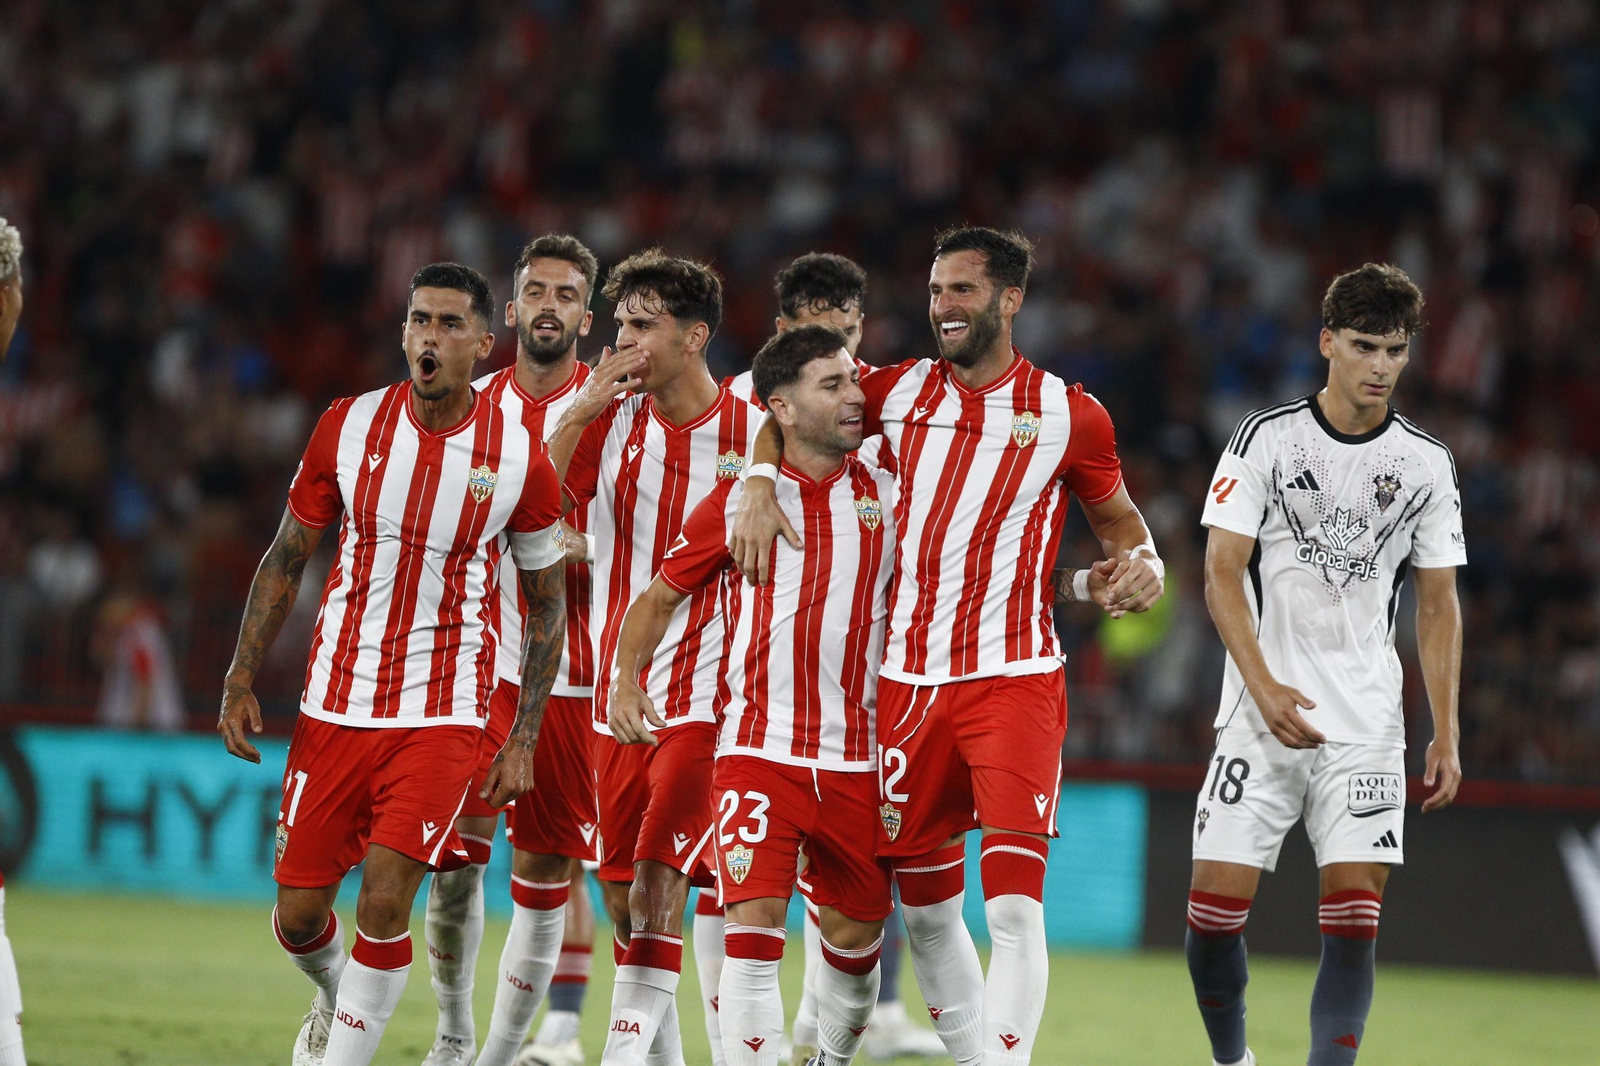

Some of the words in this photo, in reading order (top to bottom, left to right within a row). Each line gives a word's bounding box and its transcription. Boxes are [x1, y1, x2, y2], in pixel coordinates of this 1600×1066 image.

[1296, 542, 1379, 581] Globalcaja
[877, 743, 910, 802] 12
[1208, 755, 1250, 804] 18
[1354, 777, 1399, 789] AQUA
[1355, 790, 1398, 801] DEUS
[718, 789, 771, 846] 23
[506, 971, 533, 992] UDA
[337, 1008, 366, 1032] UDA
[611, 1020, 640, 1036] UDA
